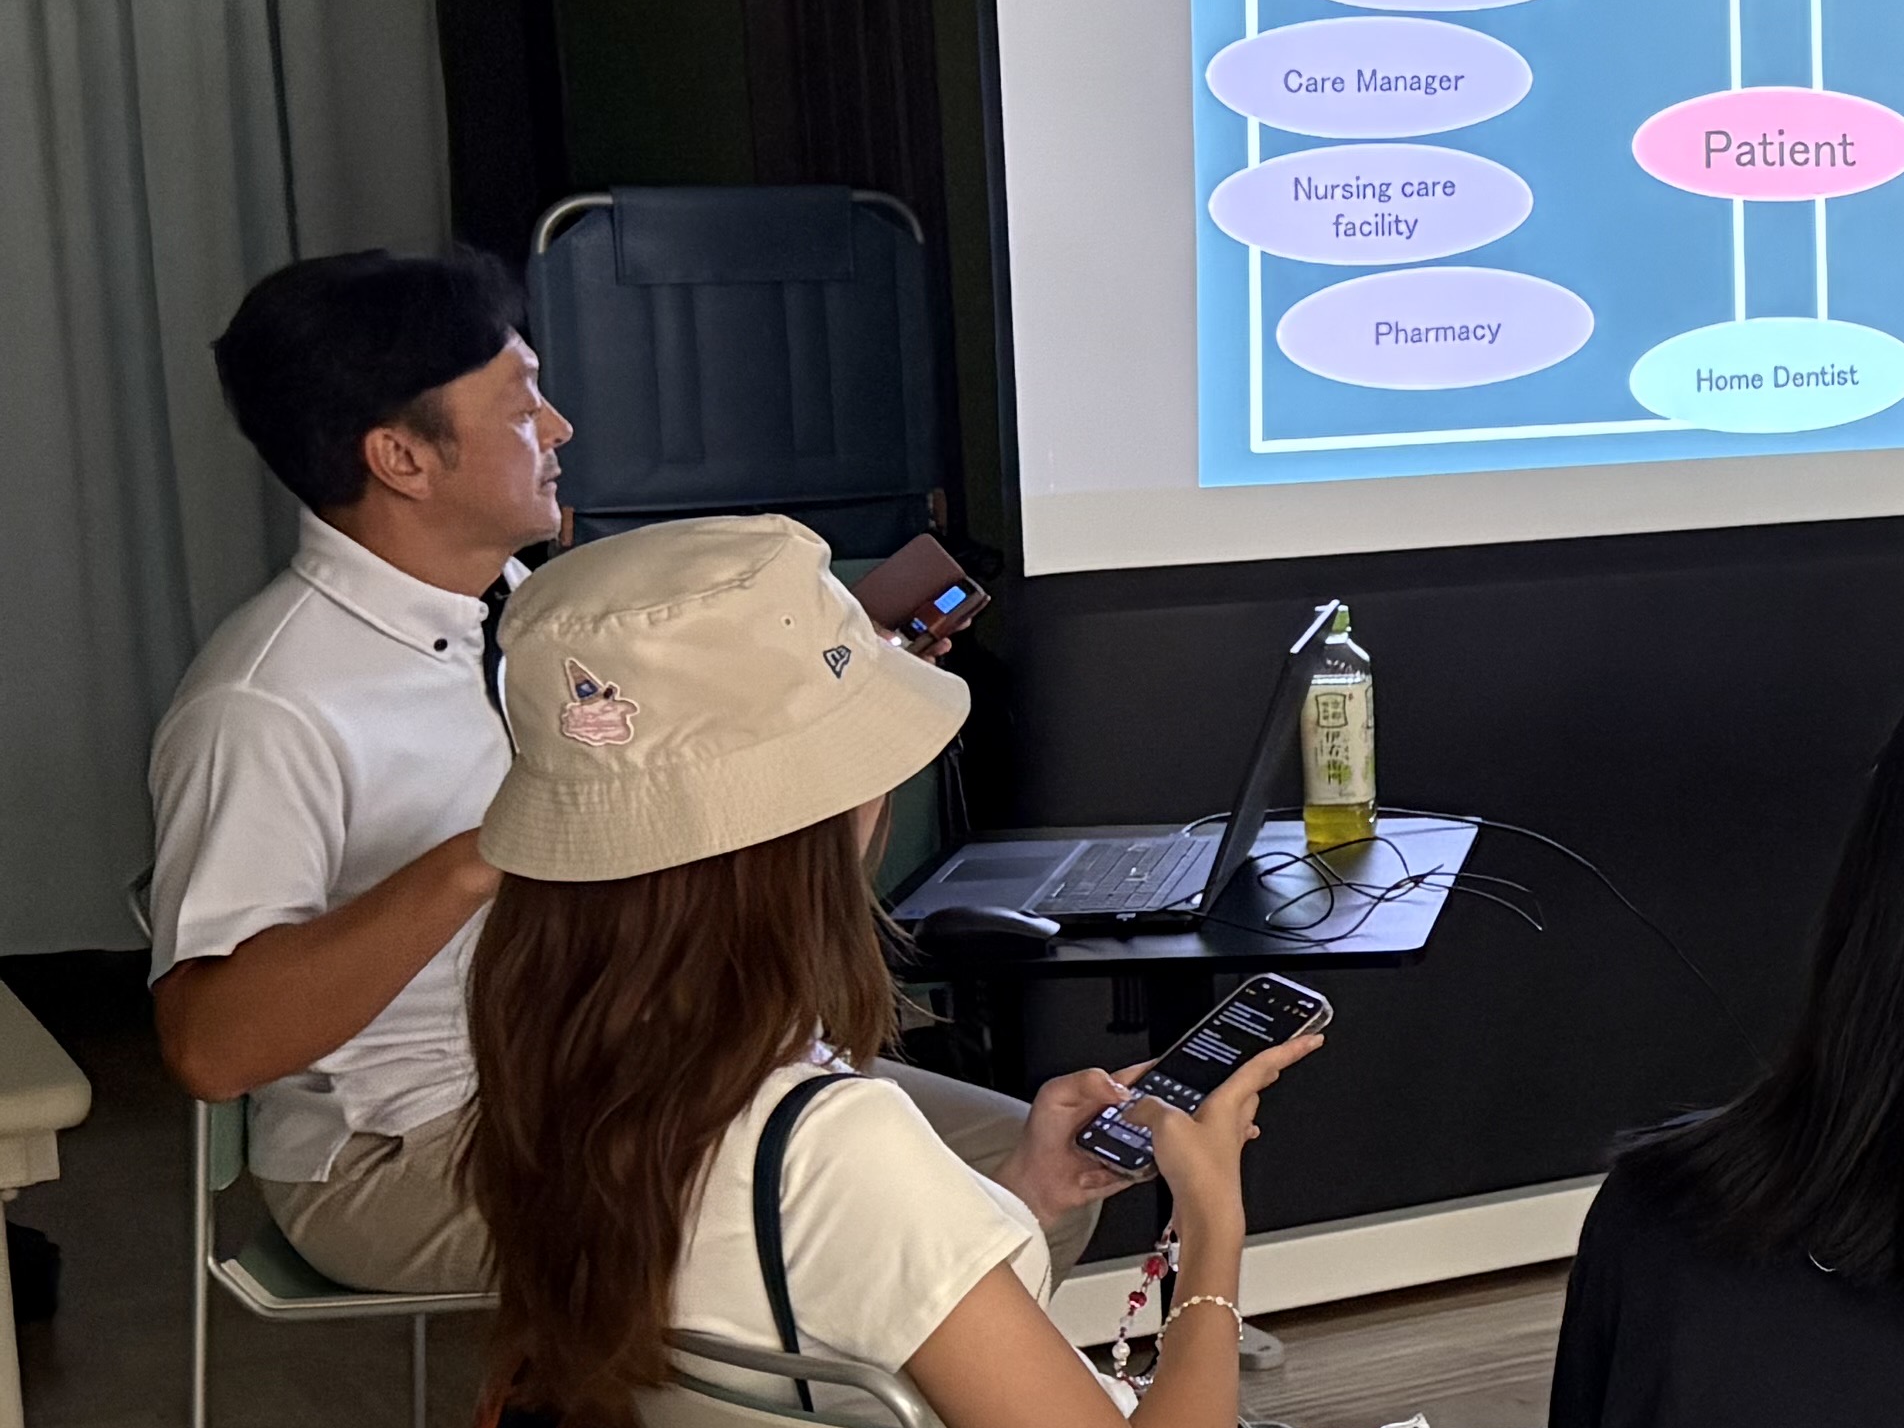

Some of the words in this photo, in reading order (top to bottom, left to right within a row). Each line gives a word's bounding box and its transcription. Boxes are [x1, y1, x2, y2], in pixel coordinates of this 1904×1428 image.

[1284, 70, 1344, 93] Care
[1357, 69, 1464, 95] Manager
[1705, 129, 1856, 168] Patient
[1294, 176, 1392, 203] Nursing
[1401, 181, 1455, 197] care
[1333, 213, 1418, 240] facility
[1376, 321, 1501, 345] Pharmacy
[1697, 369, 1763, 392] Home
[1774, 364, 1859, 388] Dentist
